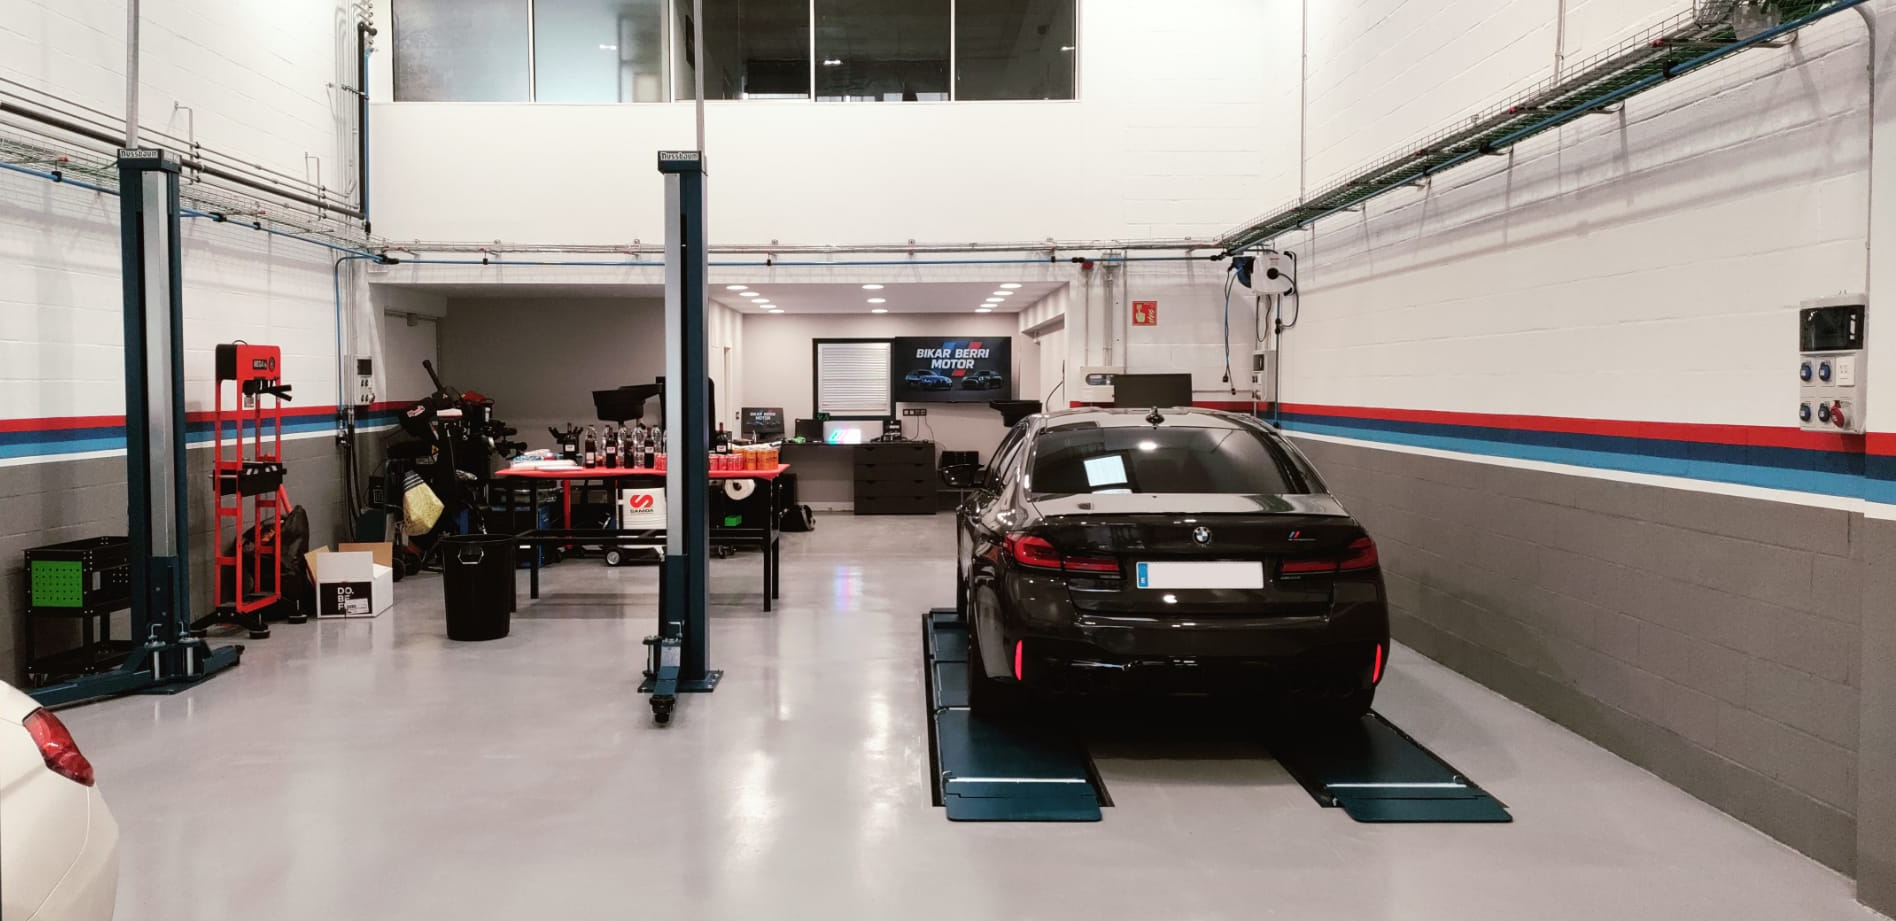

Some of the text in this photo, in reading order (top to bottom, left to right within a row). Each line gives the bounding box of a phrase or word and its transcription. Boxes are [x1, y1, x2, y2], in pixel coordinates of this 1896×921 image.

[915, 348, 990, 359] BIKAR BERRI
[930, 359, 975, 369] MOTOR
[337, 586, 354, 595] DO.
